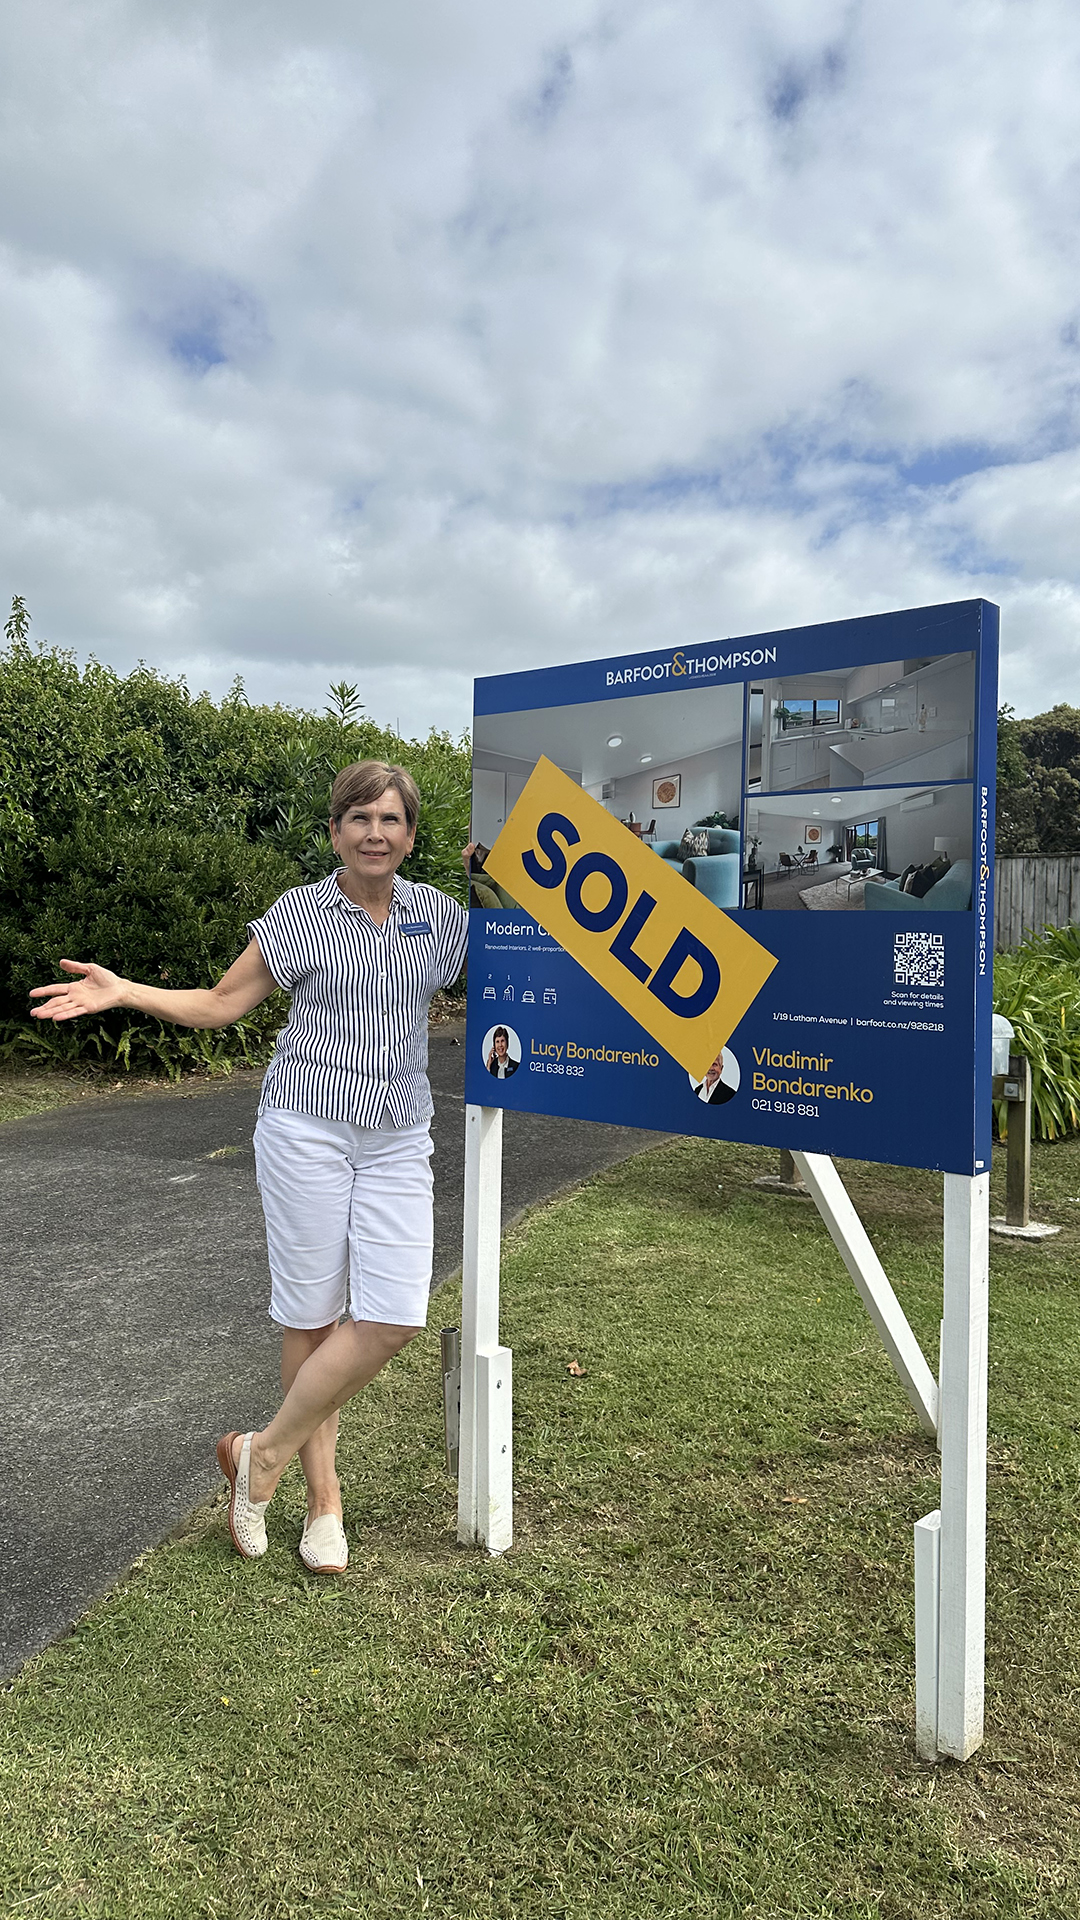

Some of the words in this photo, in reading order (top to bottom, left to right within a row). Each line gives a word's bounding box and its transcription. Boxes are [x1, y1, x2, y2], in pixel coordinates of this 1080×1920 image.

[606, 647, 777, 686] BARFOOT&THOMPSON
[979, 786, 990, 976] BARFOOT&THOMPSON
[521, 812, 721, 1019] SOLD
[485, 921, 534, 936] Modern
[537, 923, 551, 936] C
[484, 943, 508, 951] Renovated
[883, 998, 897, 1006] and
[897, 999, 924, 1009] viewing
[924, 1000, 944, 1009] times
[891, 990, 909, 999] Scan
[909, 991, 920, 999] for
[920, 992, 944, 1001] details
[772, 1012, 789, 1021] 1/19
[789, 1013, 818, 1023] Latham
[818, 1015, 848, 1025] Avenue
[856, 1018, 944, 1032] barfoot.co.nz/926218
[530, 1038, 564, 1062] Lucy
[566, 1041, 660, 1067] Bondarenko
[752, 1046, 834, 1072] Vladimir
[529, 1061, 545, 1073] 021
[546, 1063, 565, 1075] 638
[565, 1065, 585, 1077] 832
[752, 1072, 874, 1103] Bondarenko
[751, 1098, 772, 1112] 021
[773, 1101, 796, 1114] 918
[797, 1103, 820, 1118] 881
